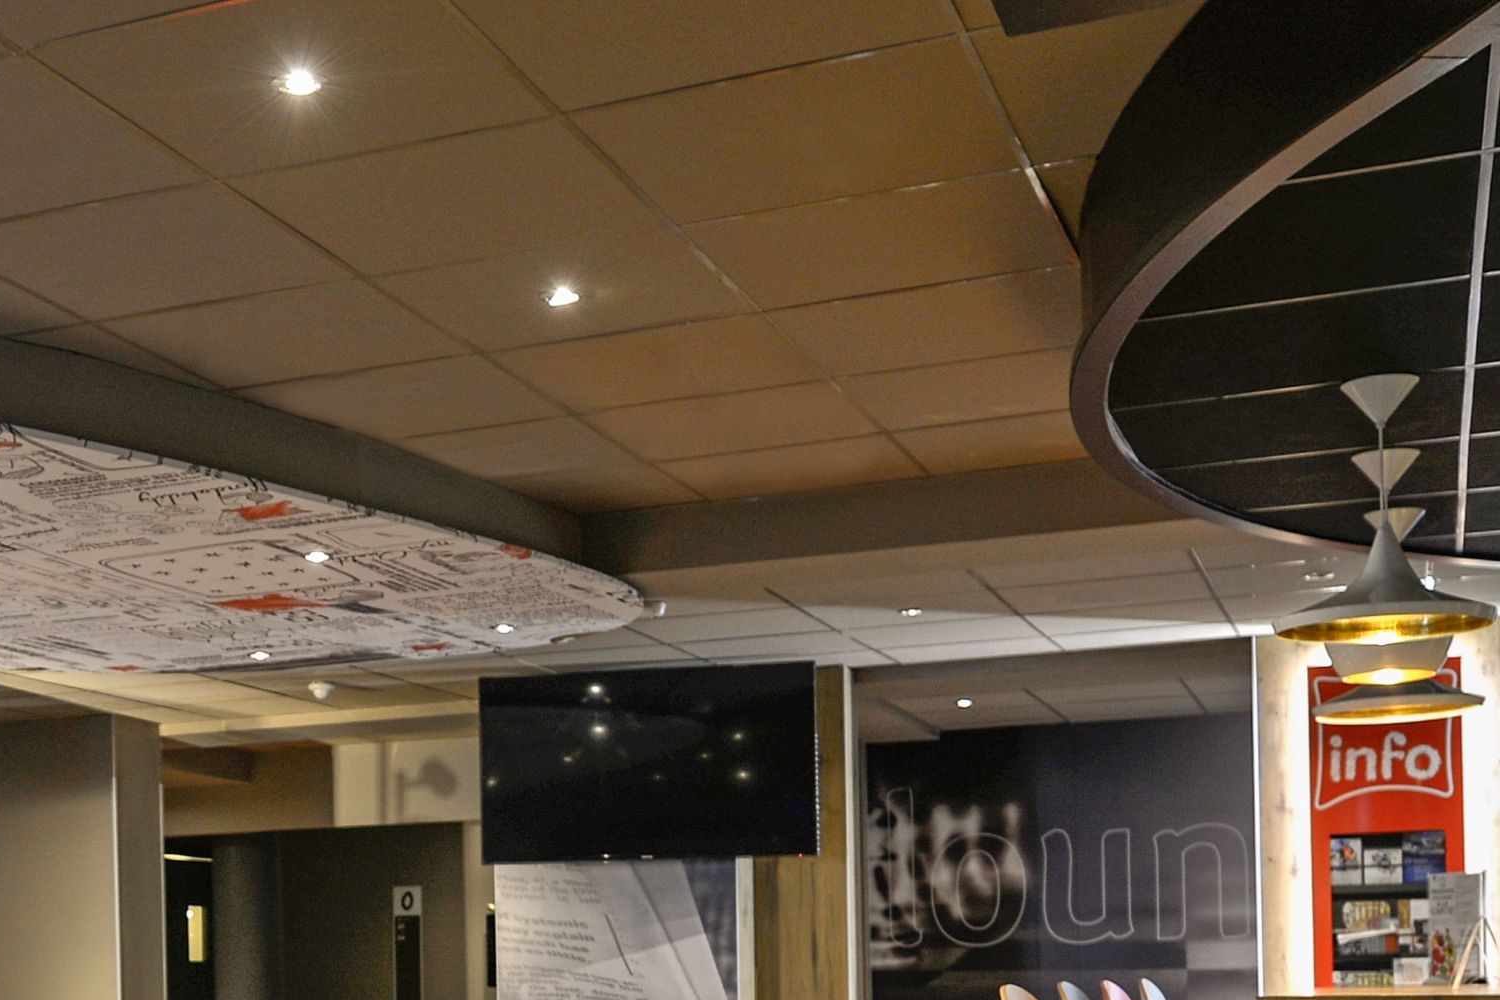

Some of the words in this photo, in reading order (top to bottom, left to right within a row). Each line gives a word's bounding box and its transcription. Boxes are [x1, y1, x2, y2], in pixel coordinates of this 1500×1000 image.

[138, 477, 268, 507] ffordability
[329, 550, 408, 566] Qualit
[1329, 731, 1442, 781] info
[886, 787, 1250, 948] loun
[401, 891, 414, 911] 0
